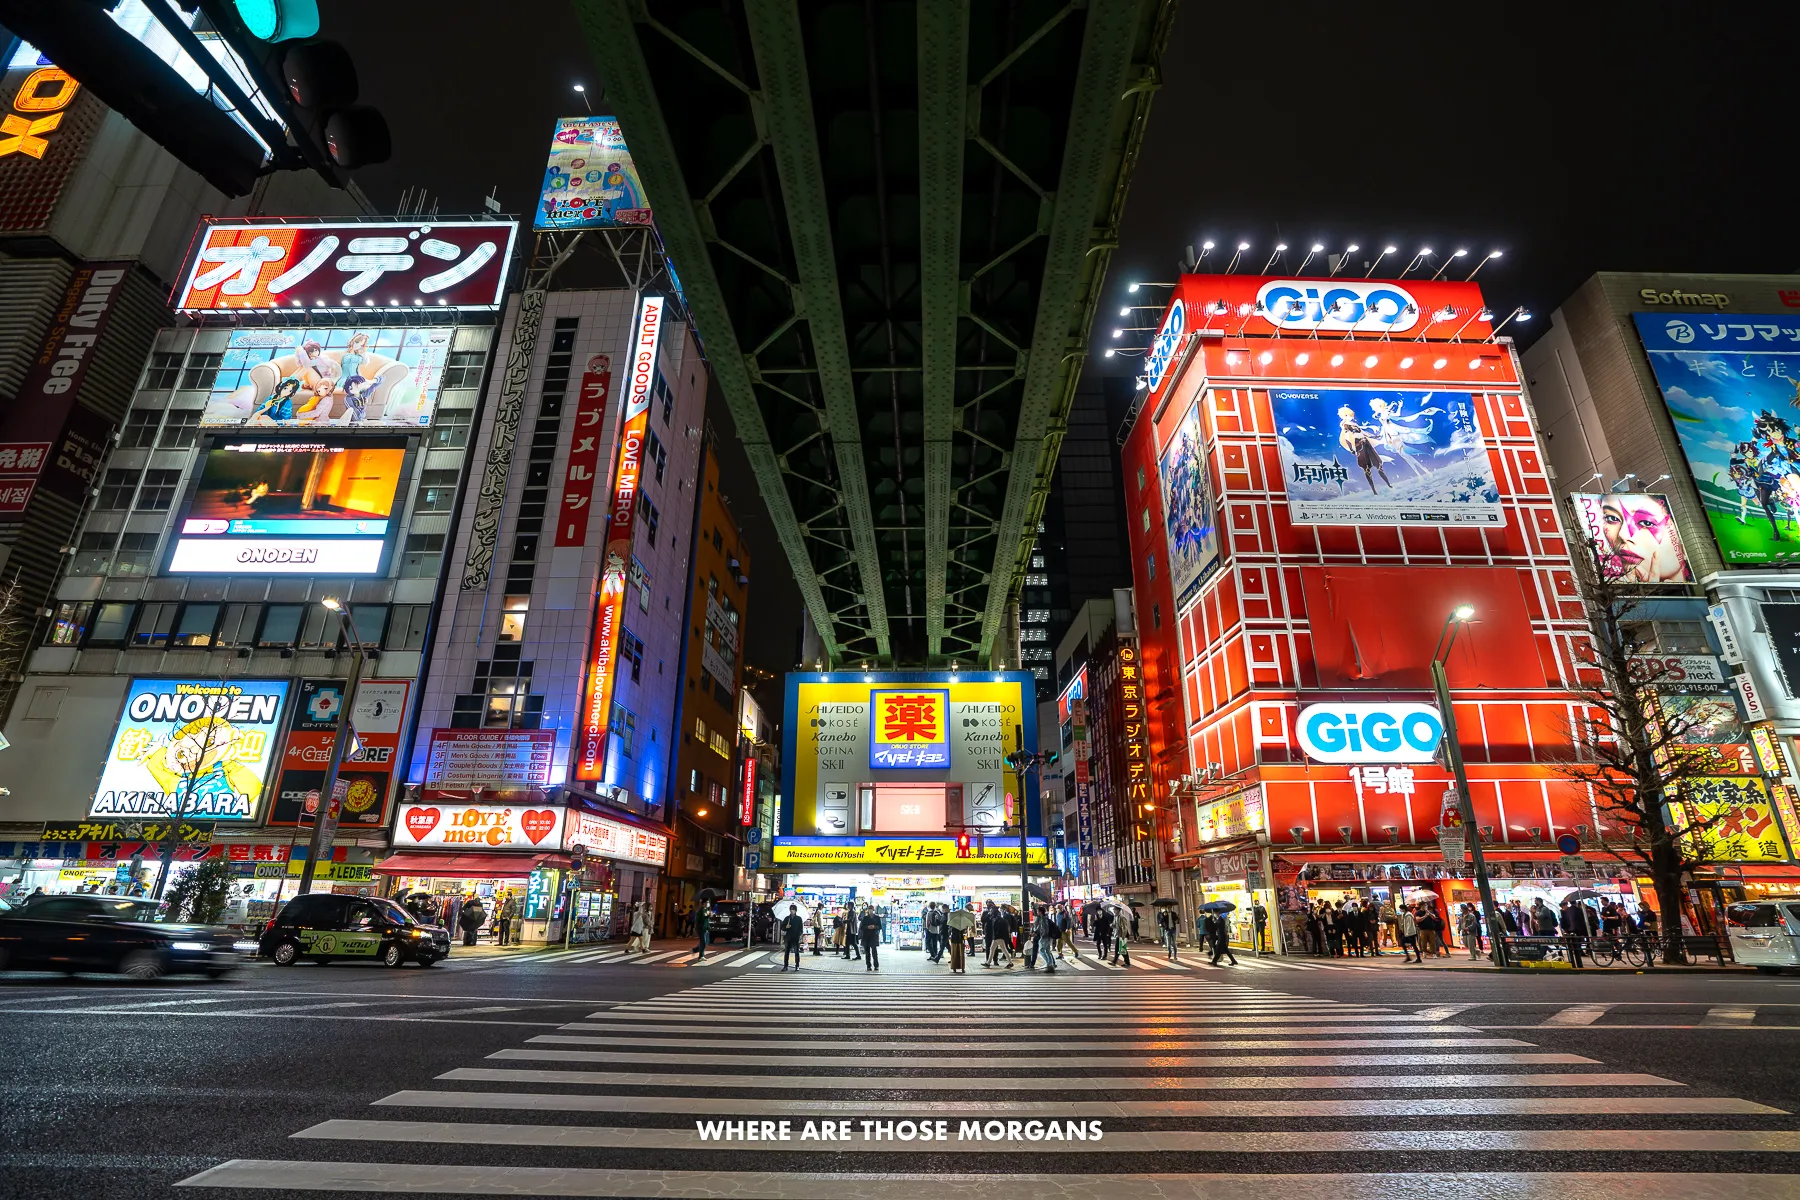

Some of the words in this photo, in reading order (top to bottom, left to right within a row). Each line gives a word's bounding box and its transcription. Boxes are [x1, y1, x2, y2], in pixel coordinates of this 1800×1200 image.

[561, 197, 604, 209] LOVE
[193, 225, 497, 296] オノデン
[57, 270, 92, 322] Flagship
[70, 269, 124, 329] Duty
[1264, 287, 1411, 323] GiGO
[1641, 289, 1730, 309] Sofmap
[640, 304, 659, 348] ADULT
[39, 323, 66, 365] Store
[43, 334, 96, 395] Free
[632, 351, 652, 404] GOODS
[1275, 392, 1319, 400] HOYOVERSE
[566, 382, 605, 539] ラブメルシー
[622, 429, 641, 471] LOVE
[1292, 454, 1349, 496] 原神
[614, 475, 635, 527] MERCI
[236, 547, 319, 564] ONODEN
[304, 683, 314, 691] 5F
[584, 604, 613, 771] www.akibalovemerci.com
[1688, 671, 1715, 680] next
[176, 684, 227, 696] Welcome
[227, 684, 242, 696] to
[1742, 682, 1758, 711] GPS
[129, 693, 280, 724] ONODEN
[805, 705, 864, 714] SHISEIDO
[884, 695, 937, 741] 薬
[957, 705, 1016, 714] SHISEIDO
[828, 718, 859, 728] KOSÉ
[981, 718, 1011, 727] KOSÉ
[1307, 712, 1443, 752] GiGO
[811, 732, 857, 742] Kanebo
[814, 746, 854, 755] SOFINA
[964, 732, 1010, 742] Kanebo
[968, 746, 1008, 755] SOFINA
[289, 746, 301, 756] 4F
[1121, 665, 1149, 842] 東京ラジオデパート
[1737, 746, 1755, 773] 2F
[1349, 766, 1415, 795] 1号館
[95, 790, 251, 816] AKIHABARA
[410, 815, 434, 825] 秋葉原
[451, 808, 510, 827] LOVE
[787, 850, 834, 859] Matsumoto
[834, 850, 864, 859] KiYoshi
[536, 878, 550, 910] 1F
